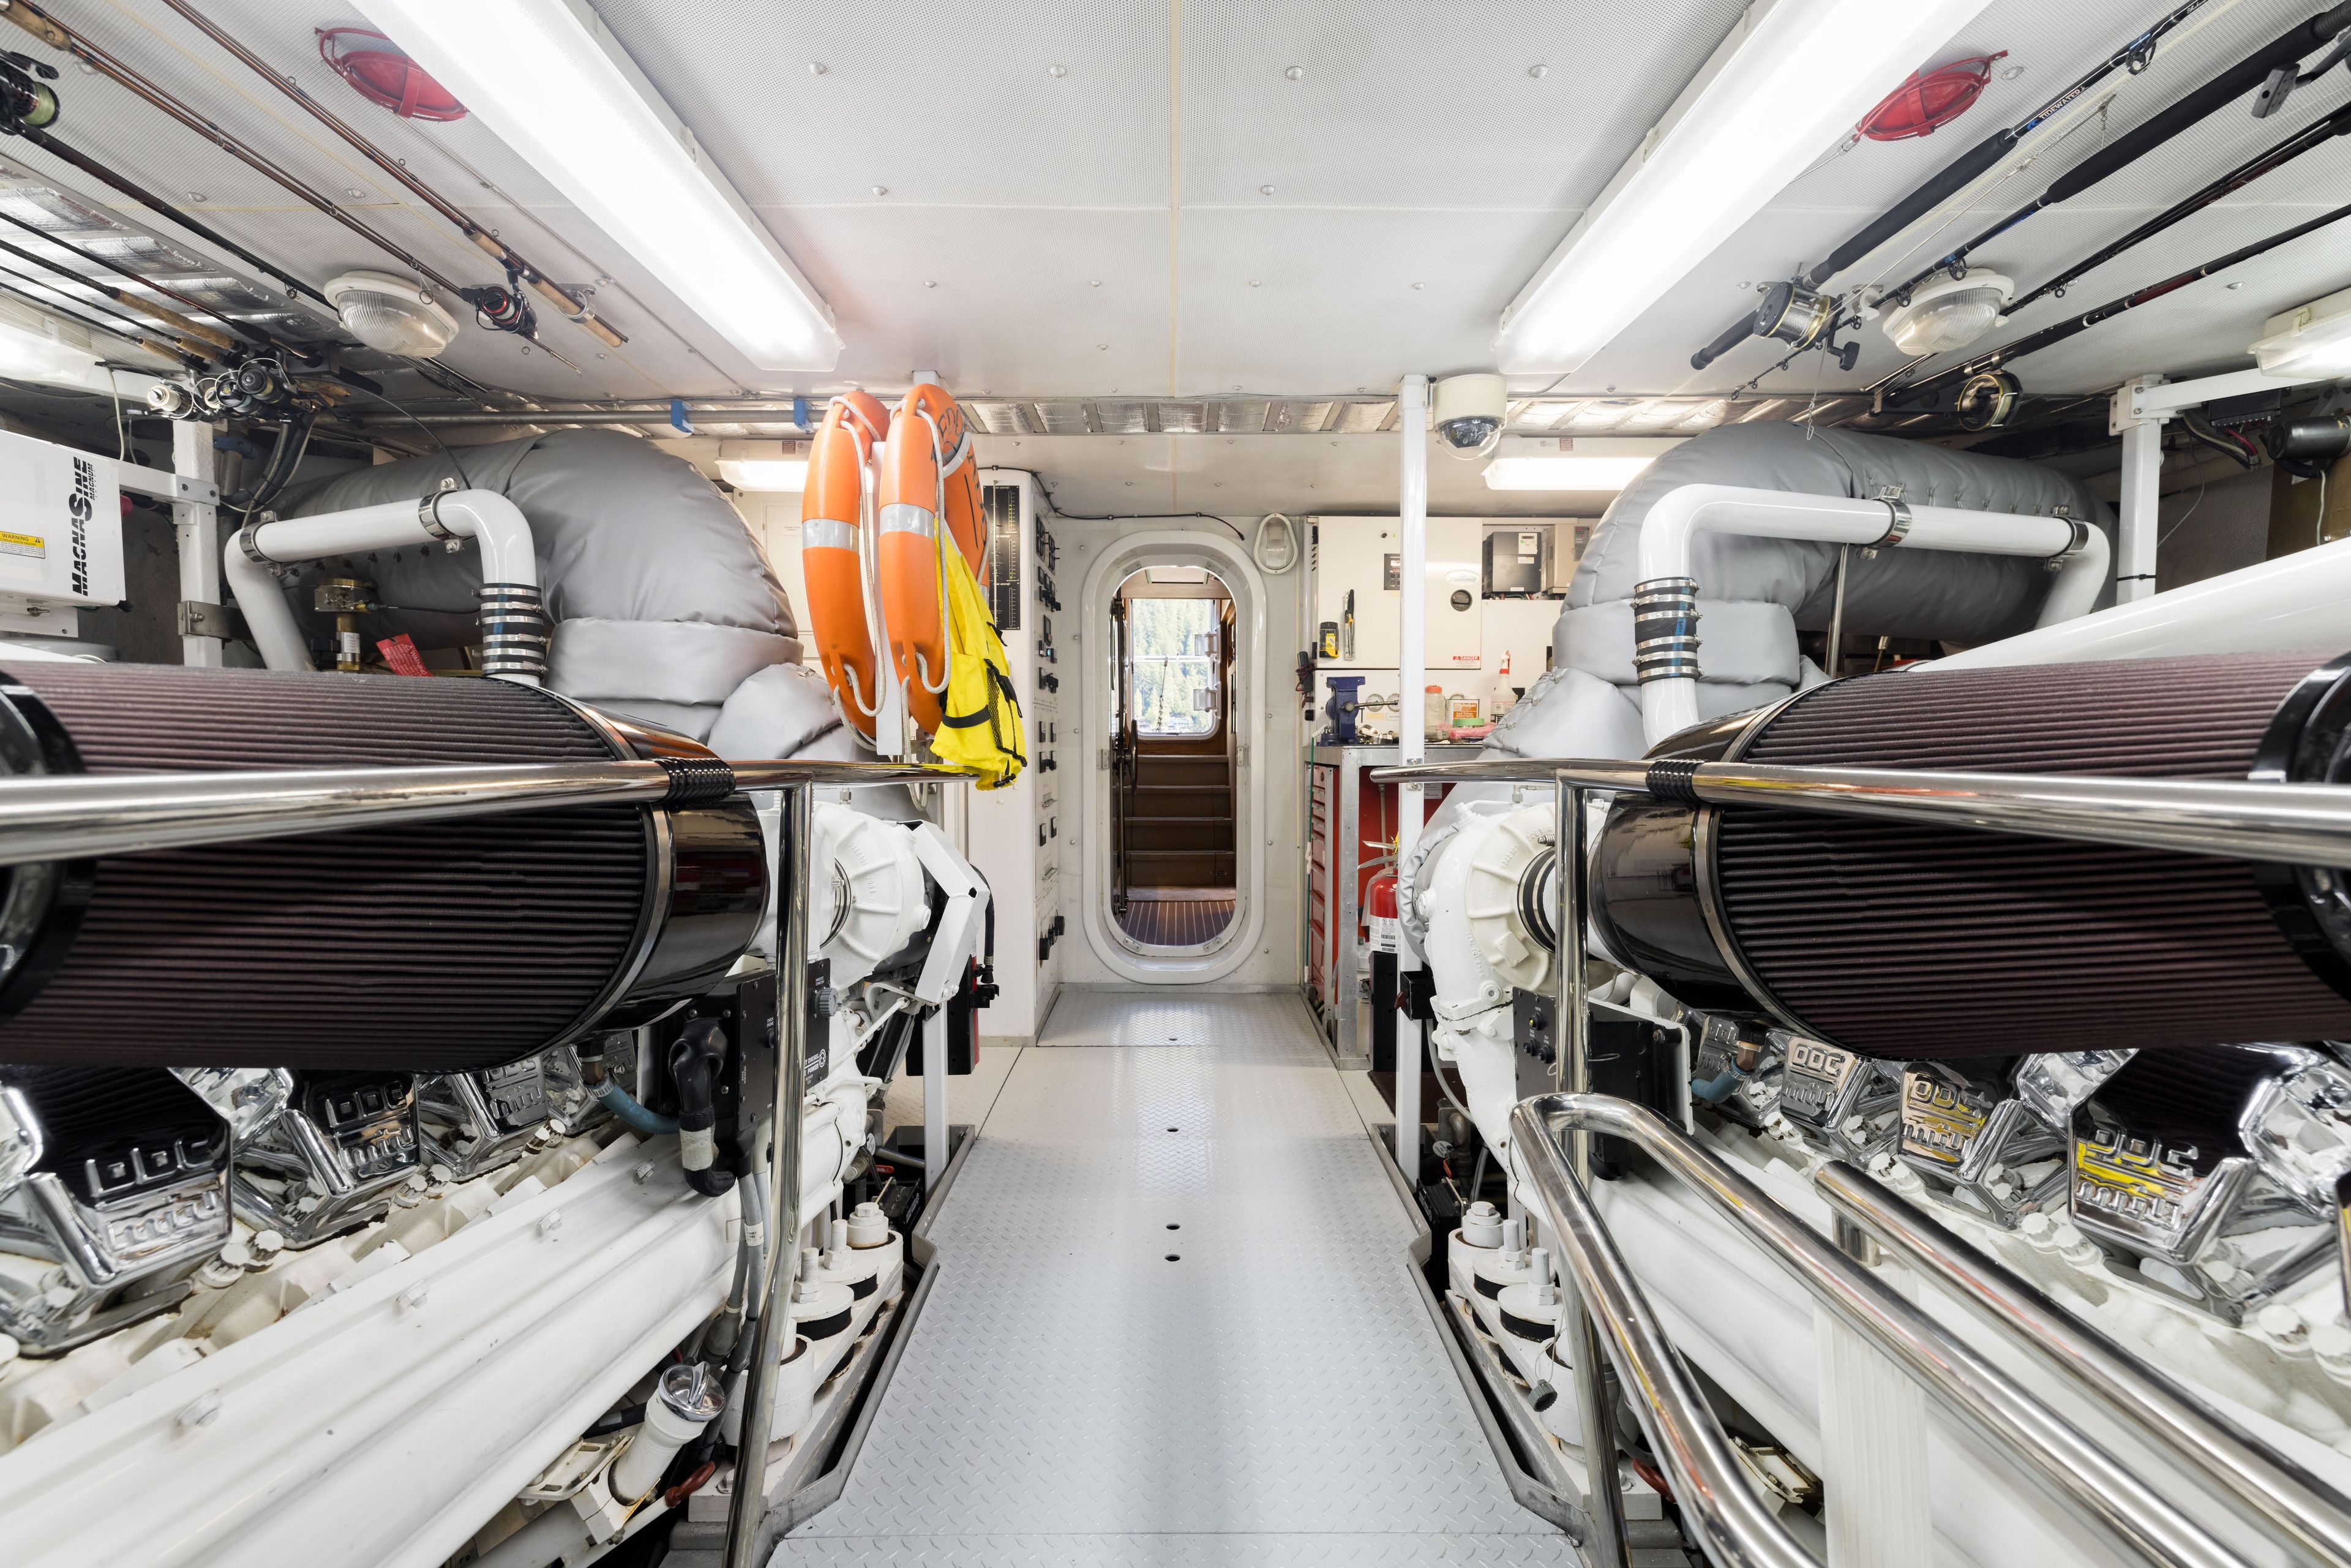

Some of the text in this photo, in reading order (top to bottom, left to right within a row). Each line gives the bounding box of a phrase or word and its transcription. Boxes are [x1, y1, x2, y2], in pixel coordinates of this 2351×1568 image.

[2039, 89, 2080, 119] TIDEWATER
[410, 650, 427, 675] WARNING
[808, 1053, 819, 1064] DIESEL
[807, 1063, 819, 1075] POWER
